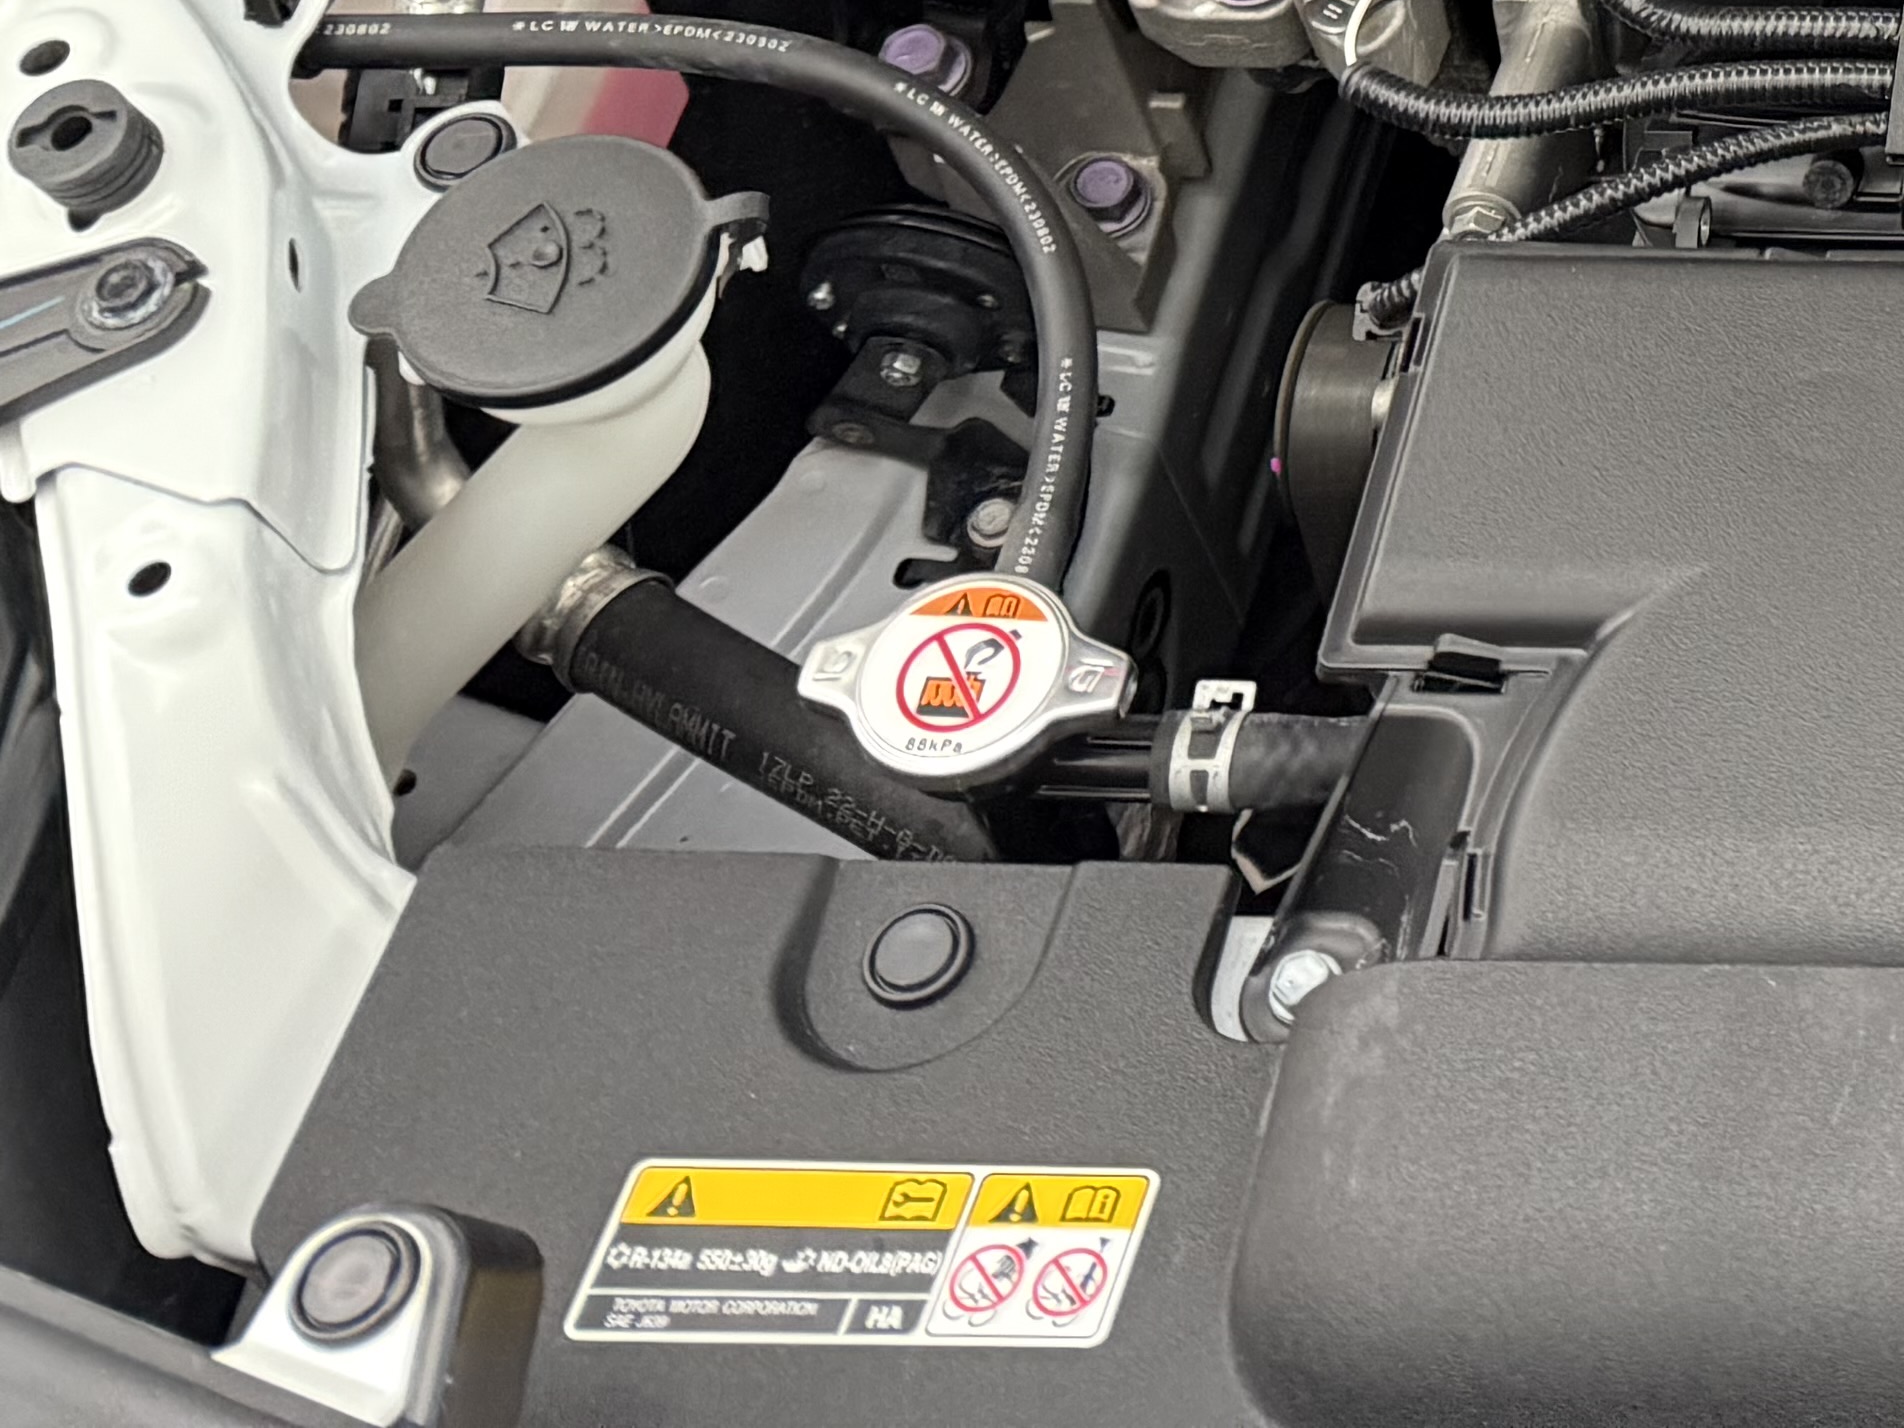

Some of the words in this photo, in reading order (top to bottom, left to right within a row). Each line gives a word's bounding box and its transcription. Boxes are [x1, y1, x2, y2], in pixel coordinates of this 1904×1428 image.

[584, 20, 649, 34] WATER
[947, 113, 993, 158] WATER
[1050, 415, 1070, 473] WATER
[905, 737, 962, 754] 88kPa
[612, 1297, 666, 1312] TOYOTA
[669, 1299, 720, 1314] MOTOR
[721, 1300, 819, 1316] CORPORATION
[865, 1304, 904, 1331] HA
